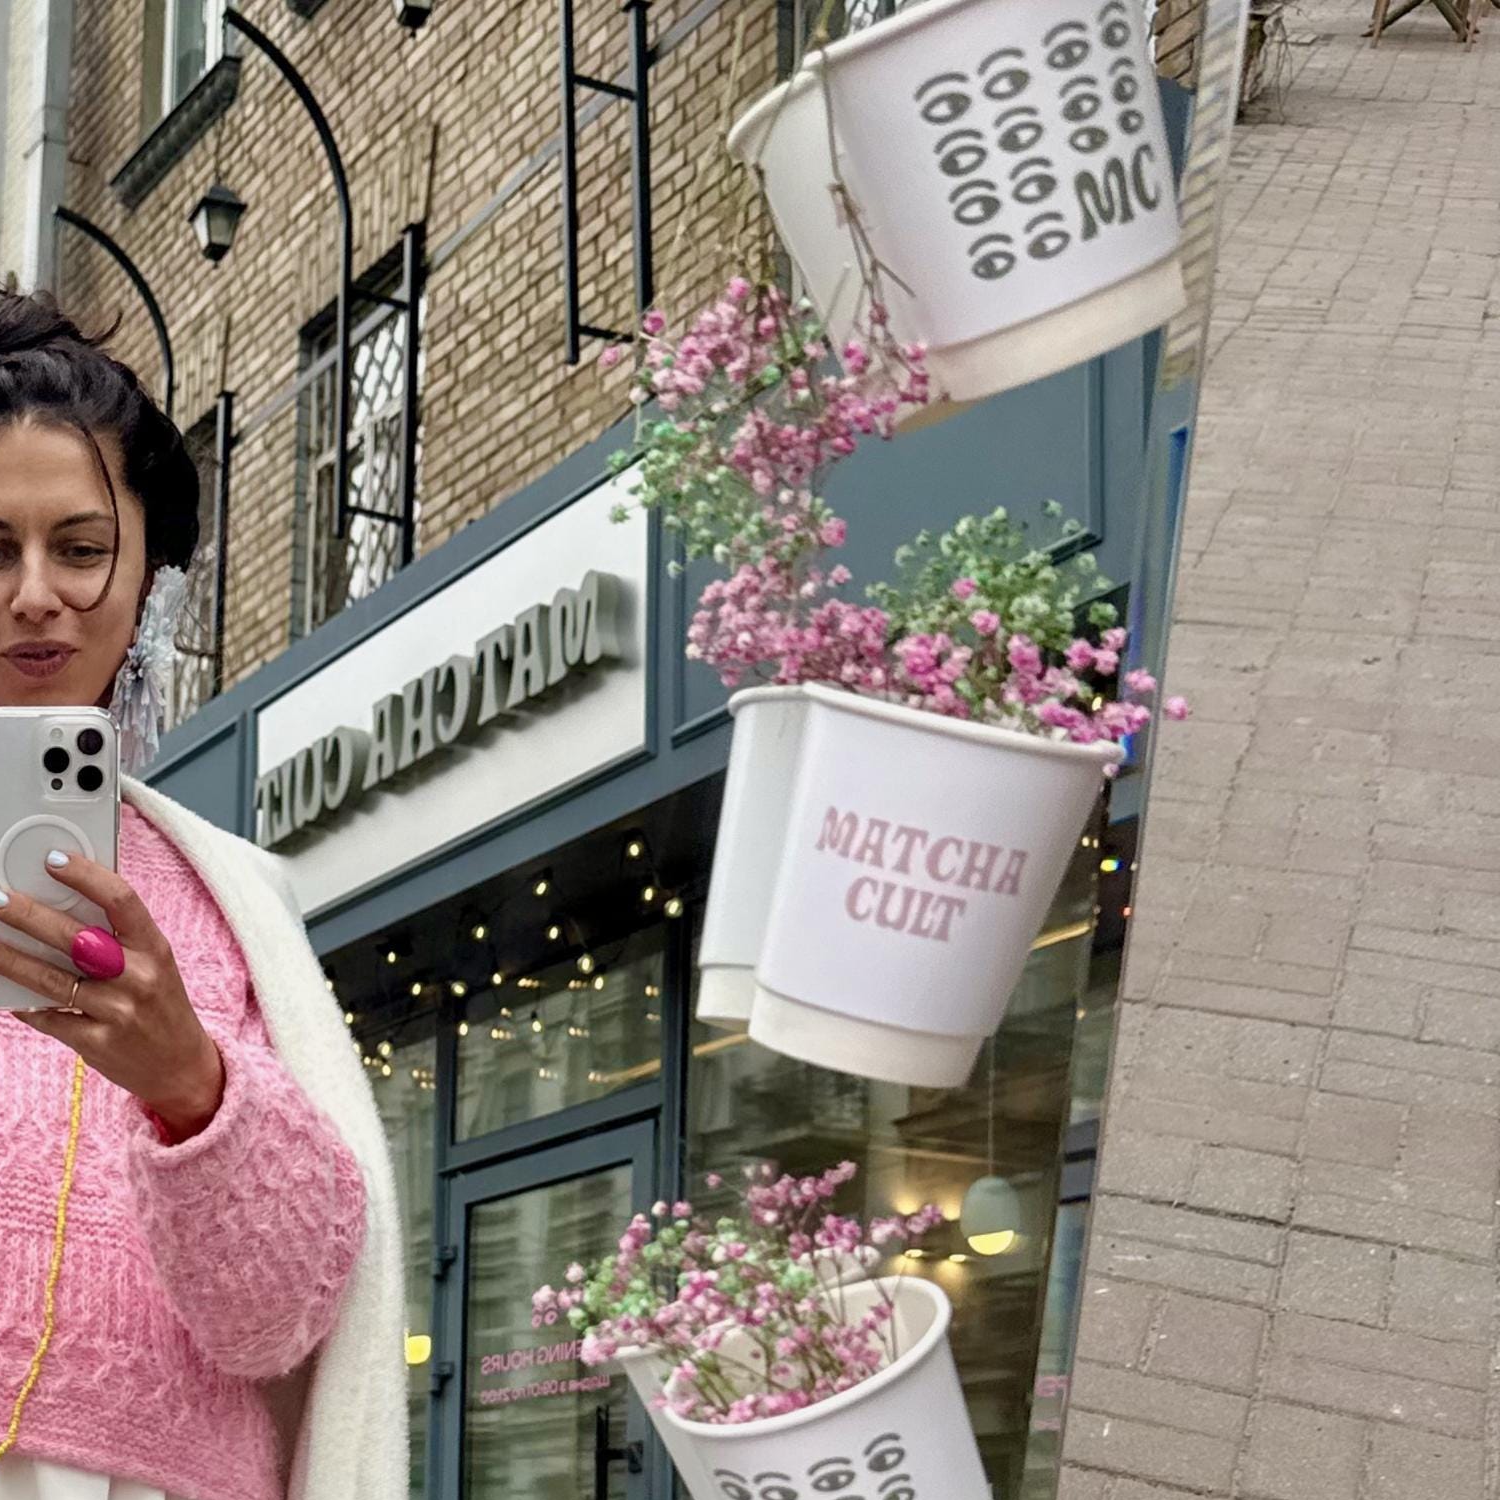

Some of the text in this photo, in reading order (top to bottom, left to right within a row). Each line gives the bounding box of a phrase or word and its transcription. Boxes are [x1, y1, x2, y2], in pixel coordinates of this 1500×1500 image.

[1072, 144, 1162, 242] MC
[815, 806, 1030, 897] MATCHA
[844, 876, 967, 943] CULT
